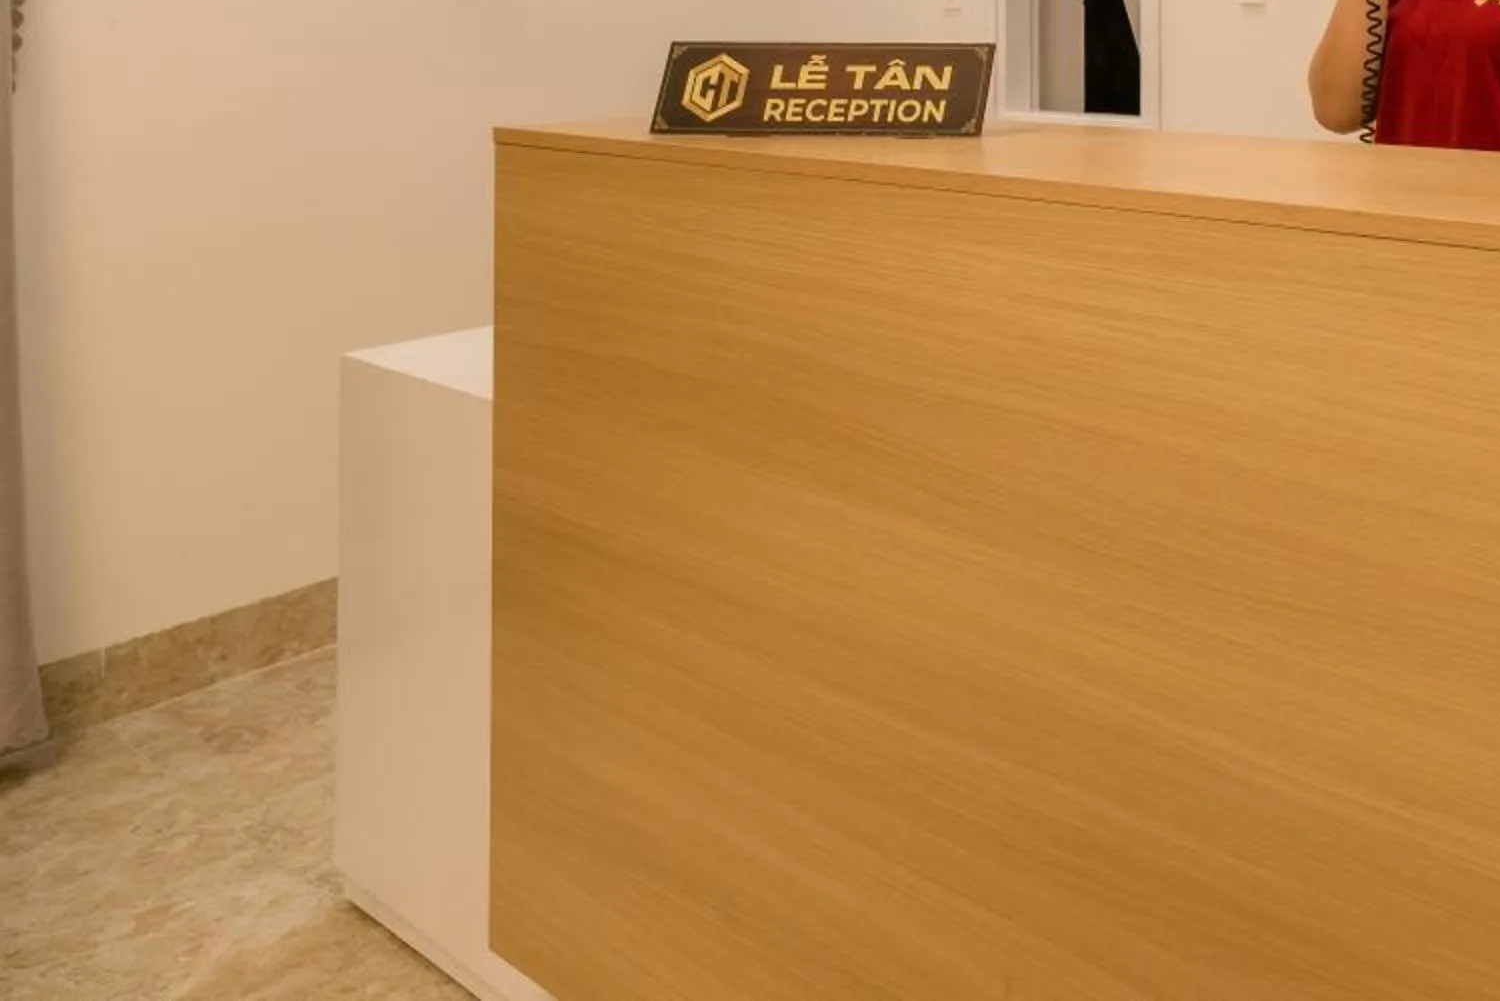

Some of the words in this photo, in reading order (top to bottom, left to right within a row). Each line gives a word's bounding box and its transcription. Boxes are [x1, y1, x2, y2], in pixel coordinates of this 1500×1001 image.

[769, 54, 829, 90] LỄ
[846, 58, 953, 91] TÂN
[763, 98, 946, 123] RECEPTION
